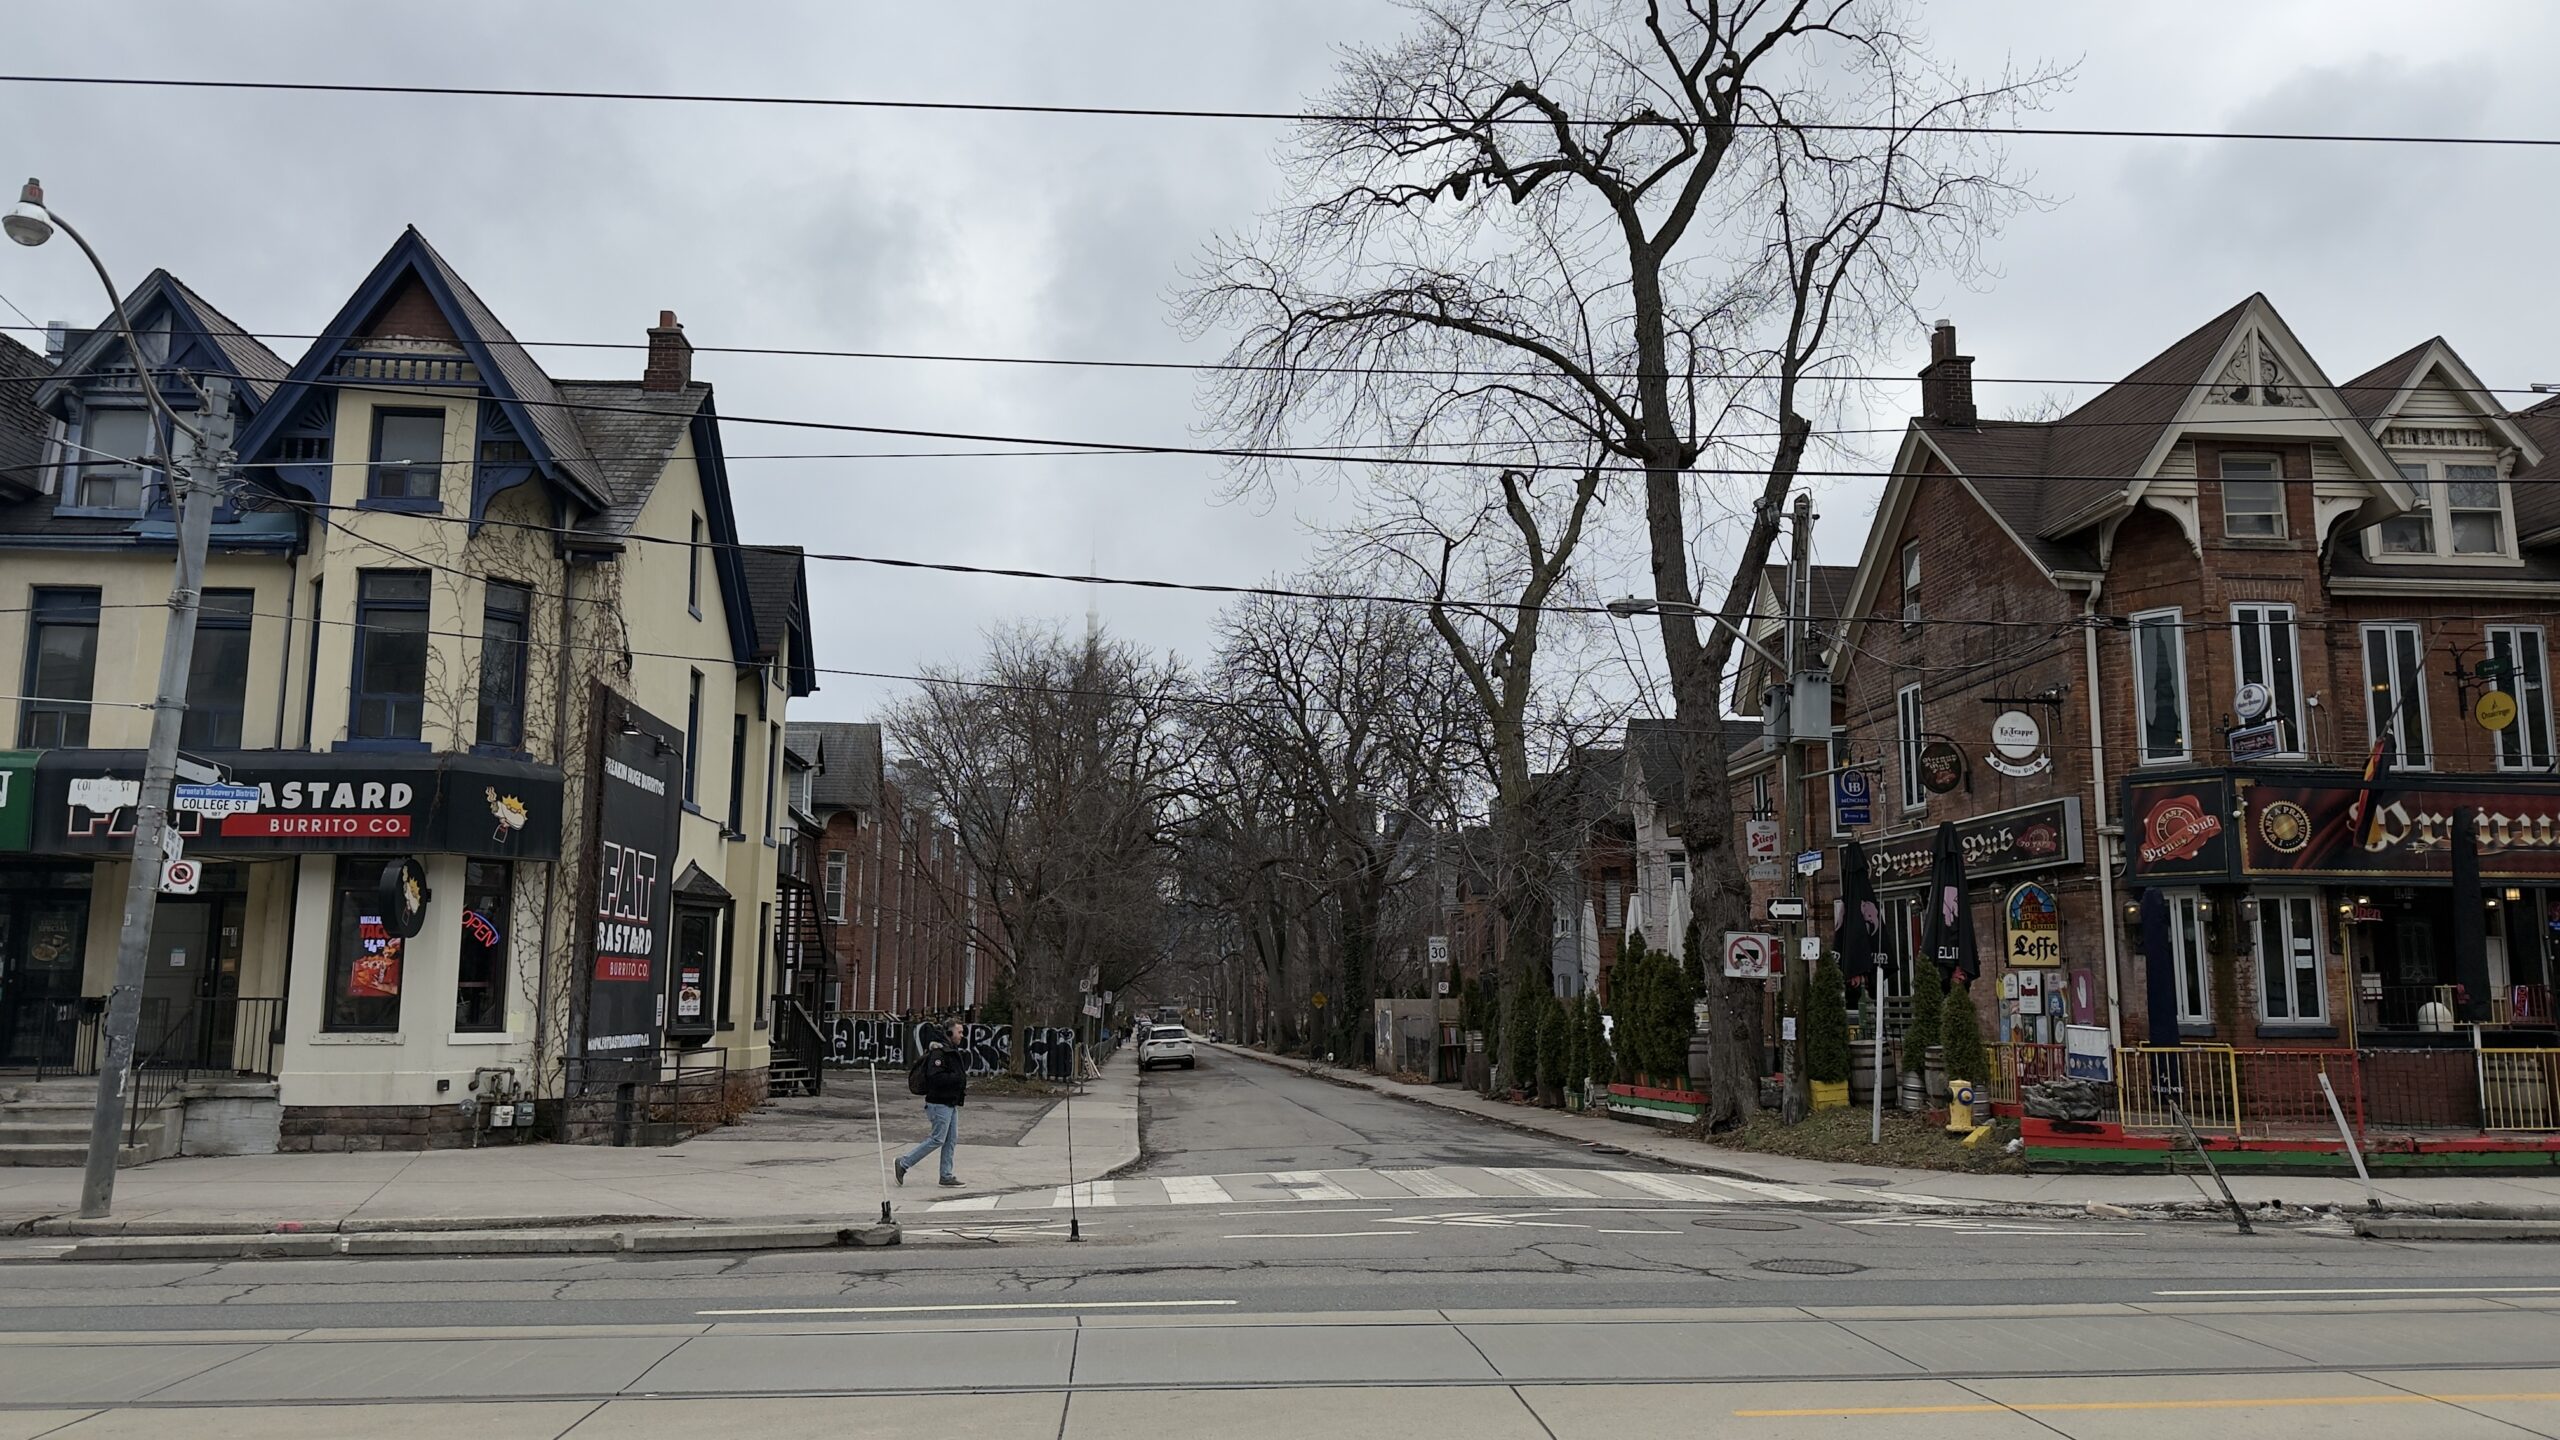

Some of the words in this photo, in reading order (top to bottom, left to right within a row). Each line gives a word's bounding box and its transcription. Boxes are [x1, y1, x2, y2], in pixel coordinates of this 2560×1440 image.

[1929, 762, 1951, 774] Pub
[178, 787, 204, 795] Toronto's
[205, 788, 234, 797] Discovery
[235, 789, 258, 798] District
[229, 781, 413, 809] ASTARD
[1848, 782, 1861, 793] HB
[182, 798, 230, 811] COLLEGE
[269, 818, 358, 833] BURRITO
[368, 818, 408, 833] CO.
[2187, 815, 2215, 835] Pub
[2346, 800, 2560, 852] Prnu
[1752, 832, 1778, 848] Stiegl
[1871, 849, 1934, 877] Prenu
[1962, 826, 2015, 862] Pub
[600, 840, 657, 921] FAT
[462, 909, 494, 947] OPEN
[597, 921, 653, 956] BASTARD
[2013, 934, 2058, 961] Leffe
[1431, 946, 1446, 959] 30
[609, 961, 636, 977] BURRITO
